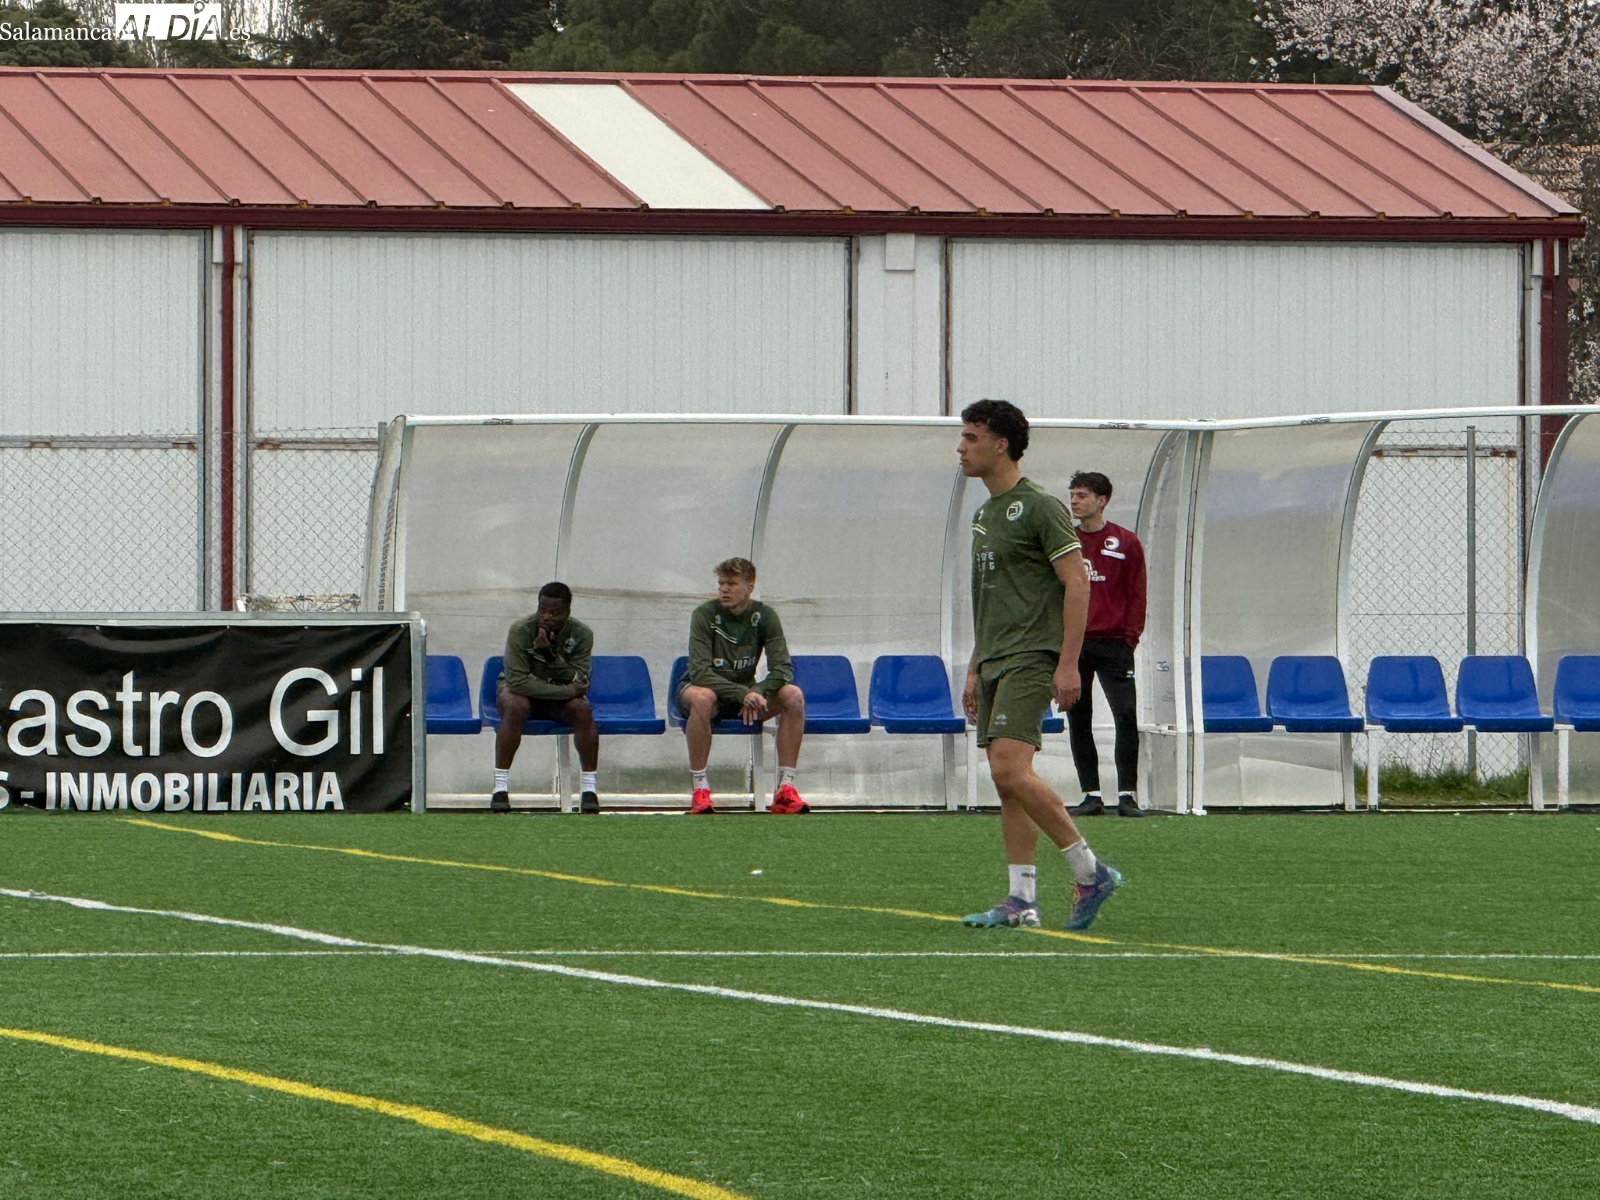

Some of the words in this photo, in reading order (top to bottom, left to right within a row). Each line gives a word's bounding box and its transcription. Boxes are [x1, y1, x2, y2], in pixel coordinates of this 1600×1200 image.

[0, 670, 233, 758] astro
[269, 666, 384, 757] Gil
[45, 771, 345, 812] INMOBILIARIA
